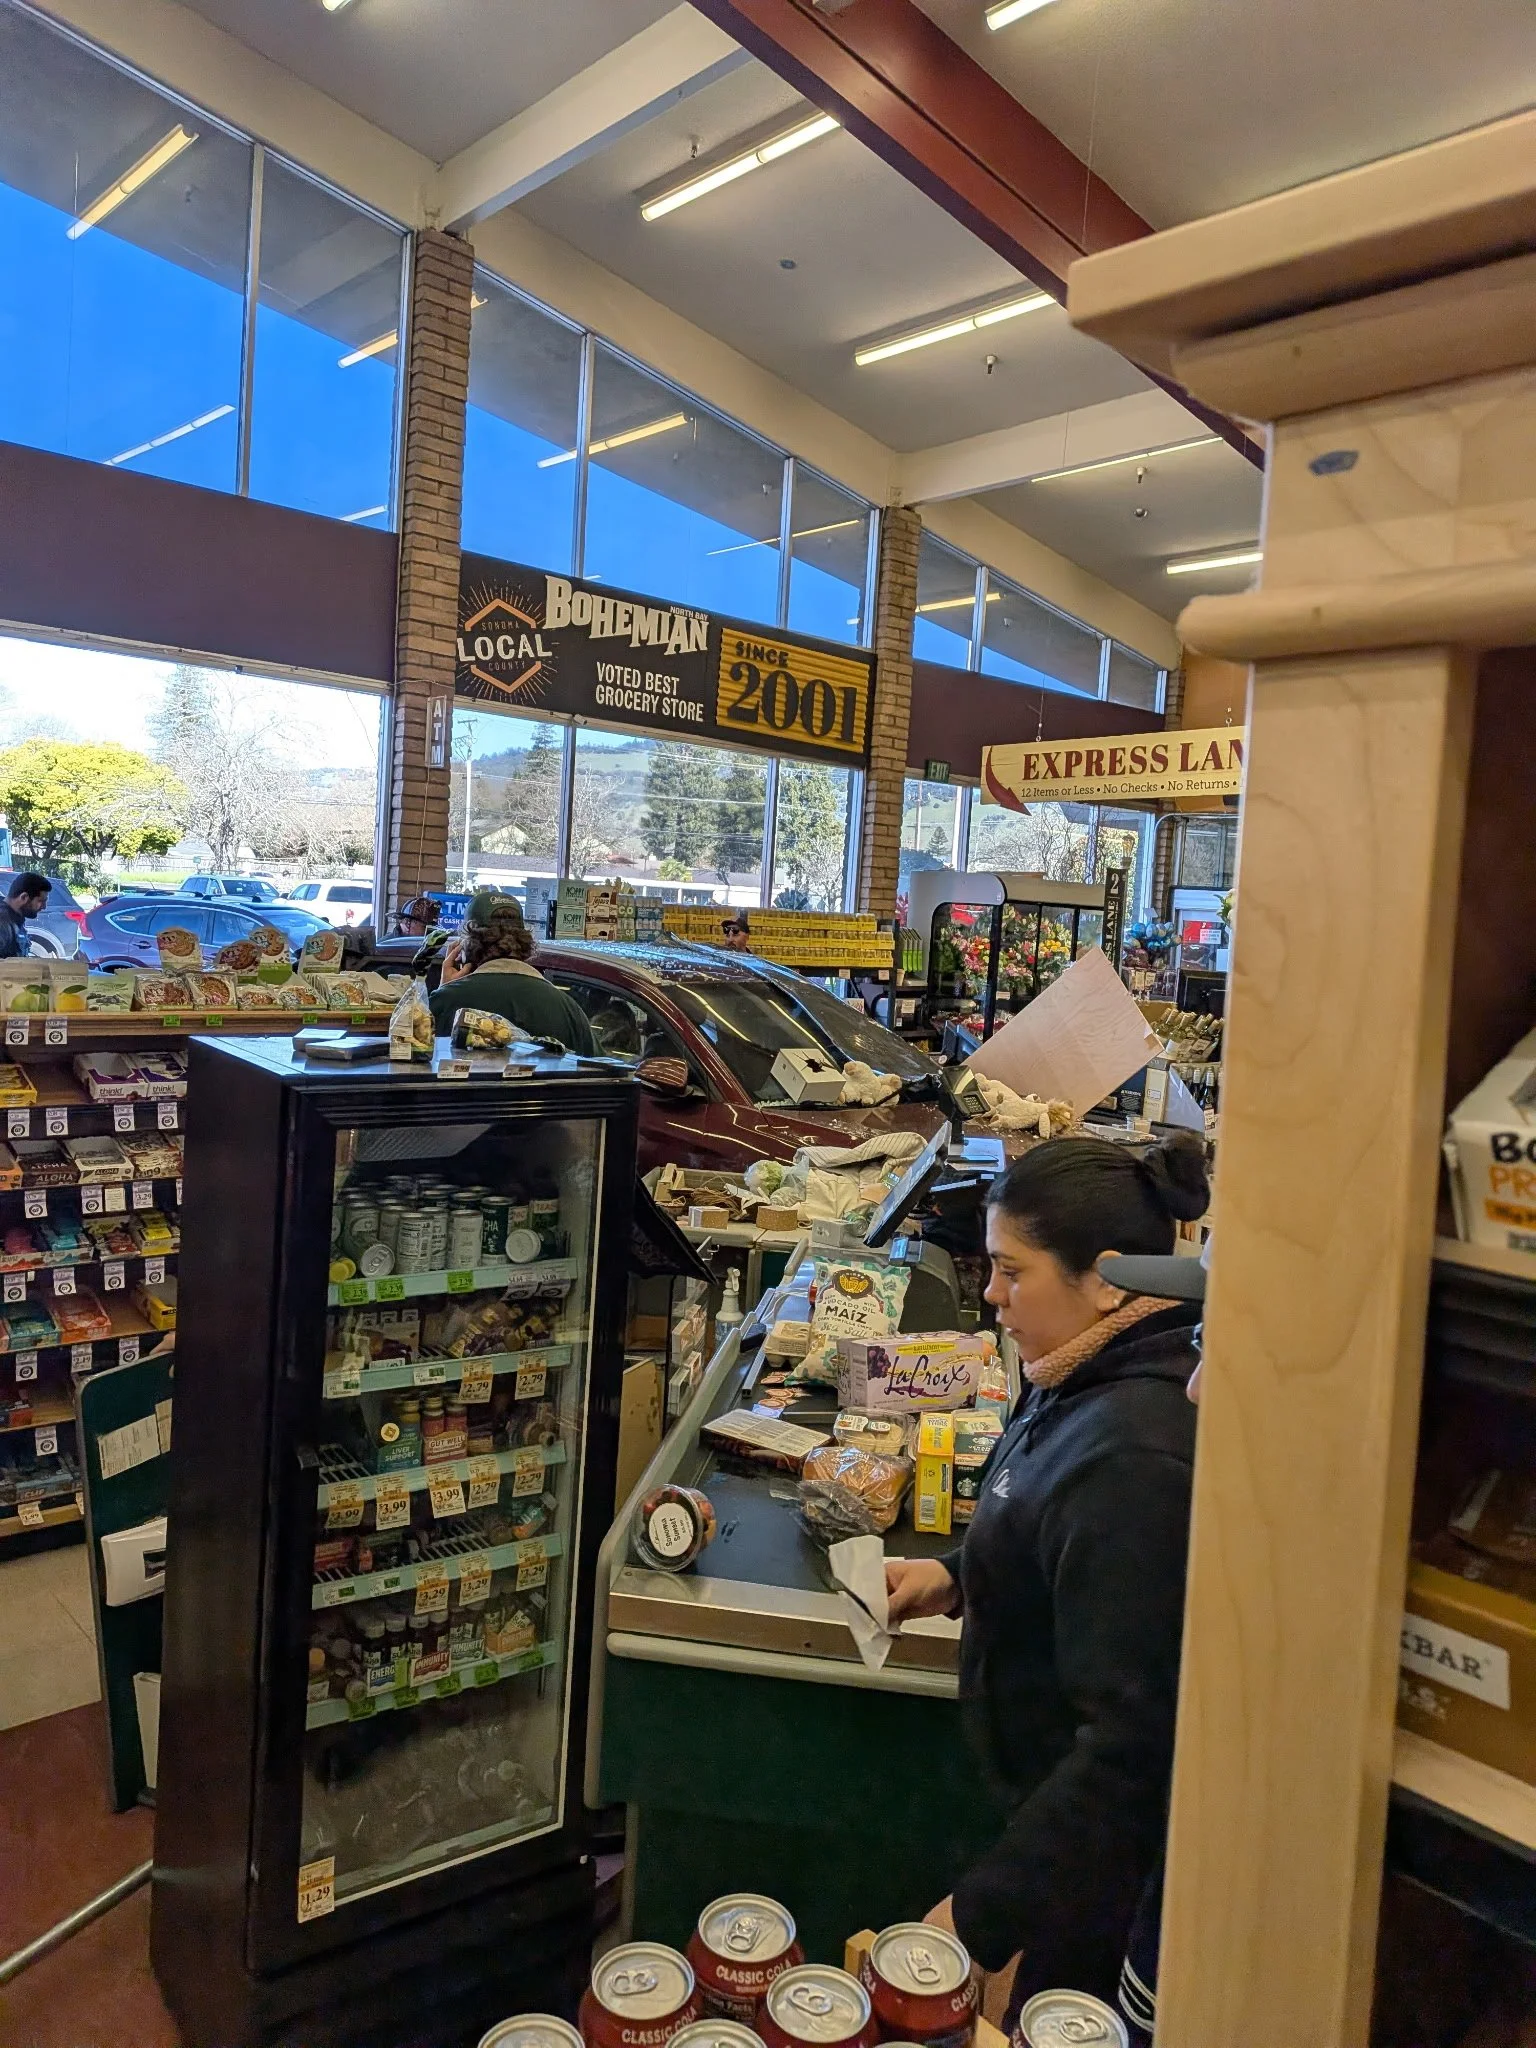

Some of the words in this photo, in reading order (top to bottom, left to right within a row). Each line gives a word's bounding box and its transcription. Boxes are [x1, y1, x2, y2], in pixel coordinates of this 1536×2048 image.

[542, 575, 710, 656] BOHEMIAN
[670, 606, 694, 618] NORTH
[694, 610, 709, 621] BAY
[481, 620, 521, 631] SONOMA
[456, 633, 553, 663] LOCAL
[735, 640, 790, 668] SINCE
[488, 659, 526, 671] COUNTY
[596, 661, 643, 690] VOTED
[645, 671, 680, 696] BEST
[595, 684, 660, 715] GROCERY
[662, 697, 705, 723] STORE
[727, 660, 859, 745] 2001
[431, 699, 443, 764] ATM
[928, 760, 949, 781] EXIT
[1020, 743, 1170, 782] EXPRESS
[1021, 787, 1031, 798] 12
[1032, 785, 1059, 797] Items
[1061, 787, 1071, 797] or
[1073, 784, 1095, 796] Less
[1102, 783, 1118, 795] No
[1119, 781, 1158, 795] Checks
[1167, 780, 1182, 792] No
[1183, 778, 1230, 792] Returns
[1109, 872, 1120, 895] 2
[1105, 900, 1117, 940] LANE
[99, 1087, 123, 1095] think!
[152, 1085, 175, 1093] think!
[823, 1296, 859, 1310] AVOCADO
[862, 1305, 875, 1314] OIL
[825, 1305, 868, 1325] MAÍZ
[820, 1322, 839, 1332] Sea
[883, 1354, 971, 1399] LaCroix
[392, 1446, 410, 1455] LIVER
[431, 1440, 445, 1448] GUT
[446, 1436, 465, 1445] WELL
[385, 1451, 416, 1461] SUPPORT
[432, 1488, 460, 1503] $3.99
[379, 1500, 407, 1515] $3.99
[661, 1517, 673, 1547] Sonoma
[669, 1517, 681, 1542] Sunset
[419, 1587, 446, 1601] $3.29
[716, 1964, 765, 1985] CLASSIC
[621, 2027, 674, 2046] CLASSIC
